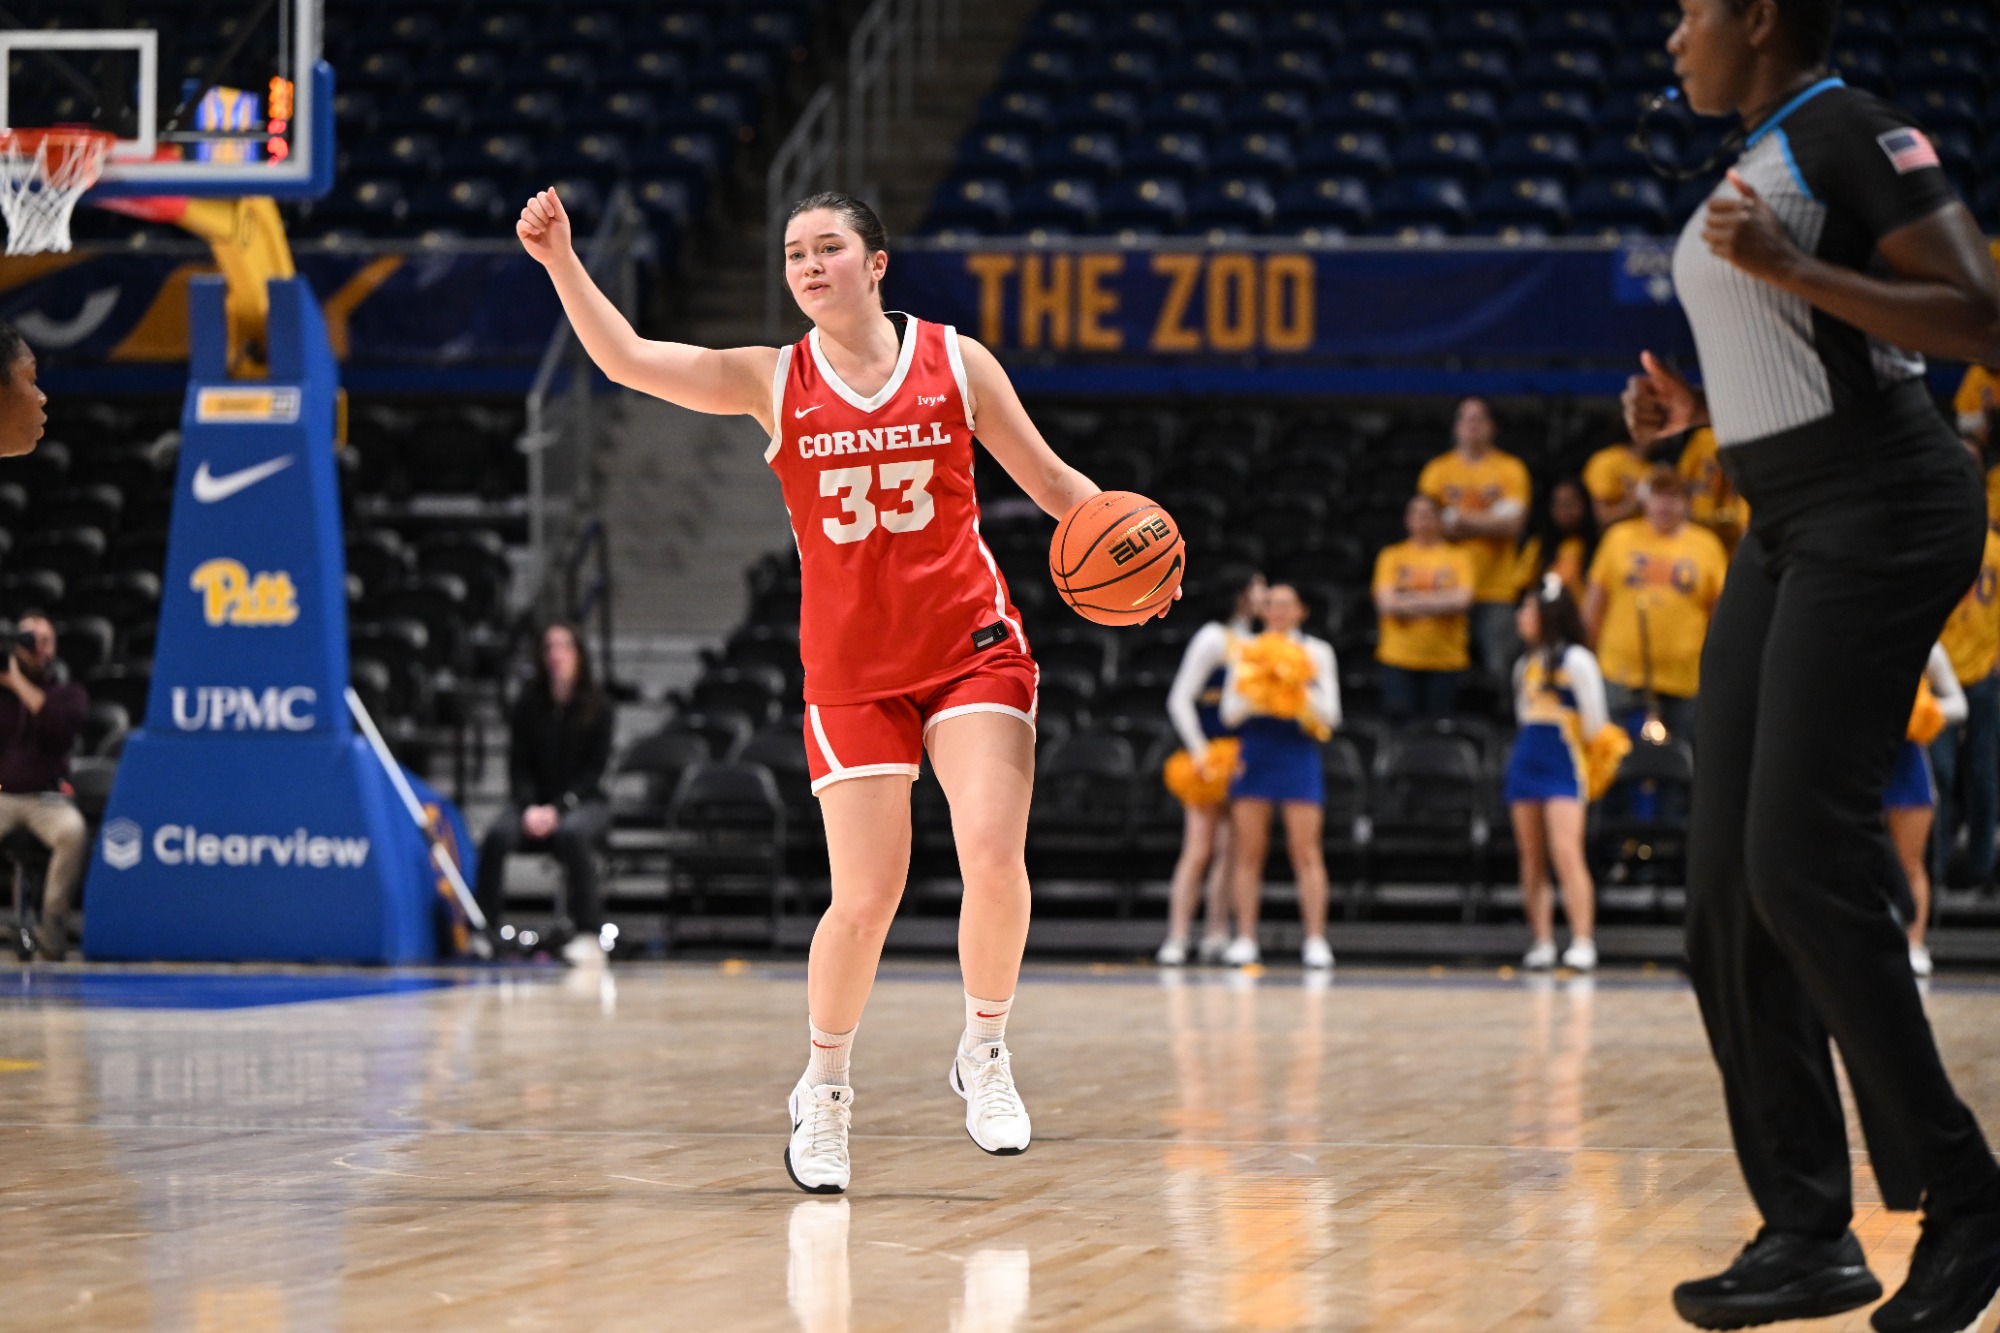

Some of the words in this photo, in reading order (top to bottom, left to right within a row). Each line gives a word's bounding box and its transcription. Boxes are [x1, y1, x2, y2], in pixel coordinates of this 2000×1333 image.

[965, 254, 1124, 349] THE
[1153, 254, 1315, 351] ZOO
[917, 395, 936, 406] Ivy
[798, 422, 951, 459] CORNELL
[819, 459, 935, 544] 33
[190, 557, 300, 628] Pitt
[172, 686, 316, 731] UPMC
[154, 824, 370, 868] Clearview
